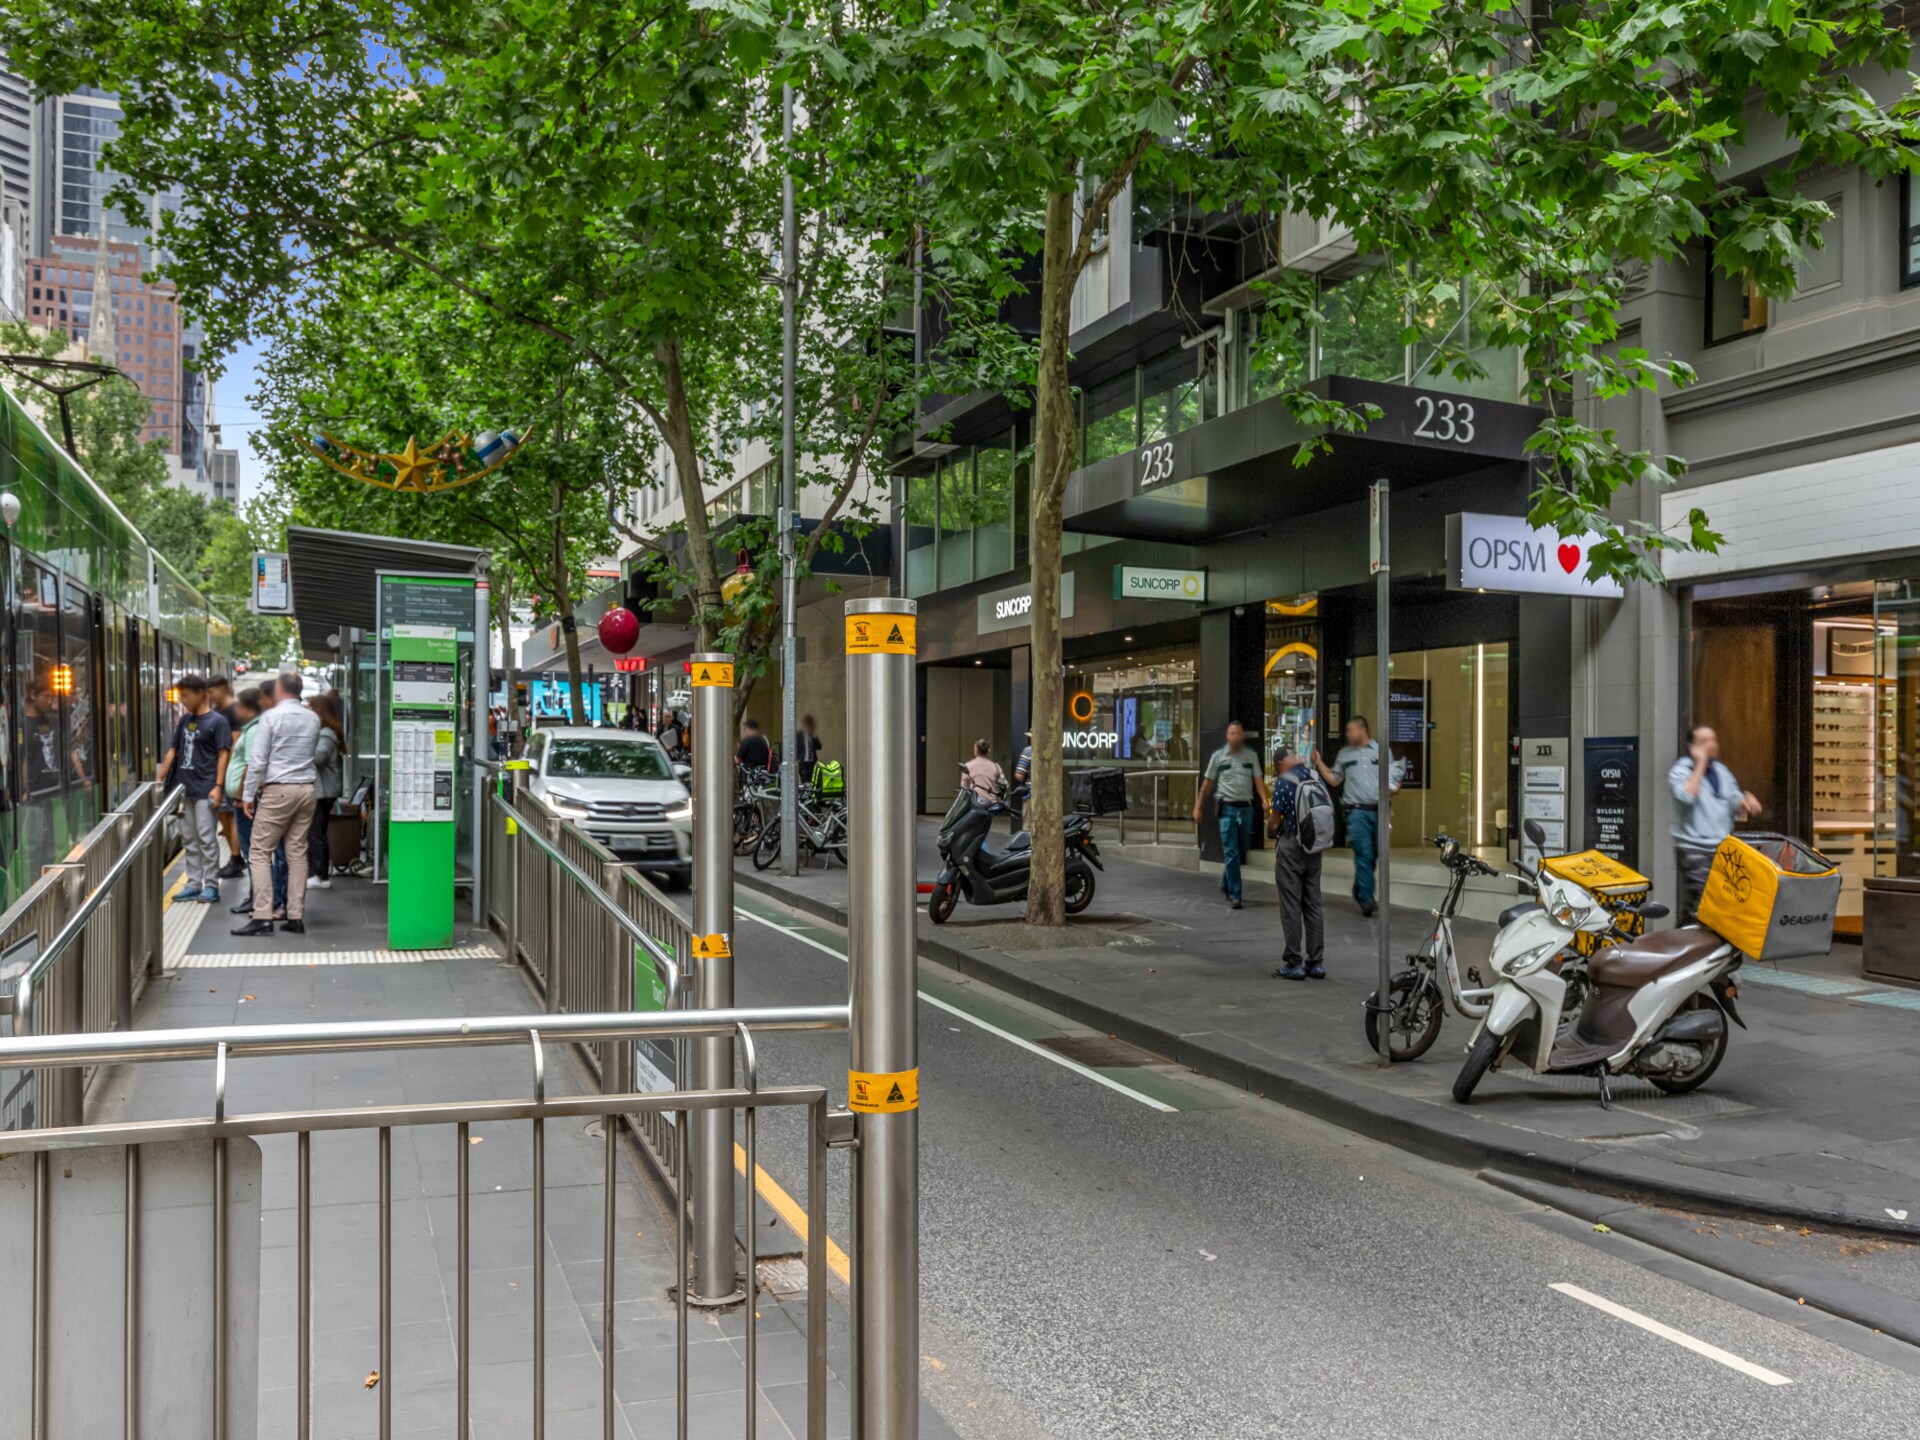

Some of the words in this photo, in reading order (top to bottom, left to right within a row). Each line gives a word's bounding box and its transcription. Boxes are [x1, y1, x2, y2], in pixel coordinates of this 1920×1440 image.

[1414, 396, 1475, 444] 233
[1140, 442, 1174, 486] 233
[1469, 537, 1546, 573] OPSM
[1130, 576, 1181, 591] SUNCORP
[996, 595, 1032, 619] SUNCORP
[427, 640, 442, 648] Town
[447, 691, 454, 703] 6
[1536, 745, 1552, 756] 233
[1601, 769, 1621, 778] OPSM
